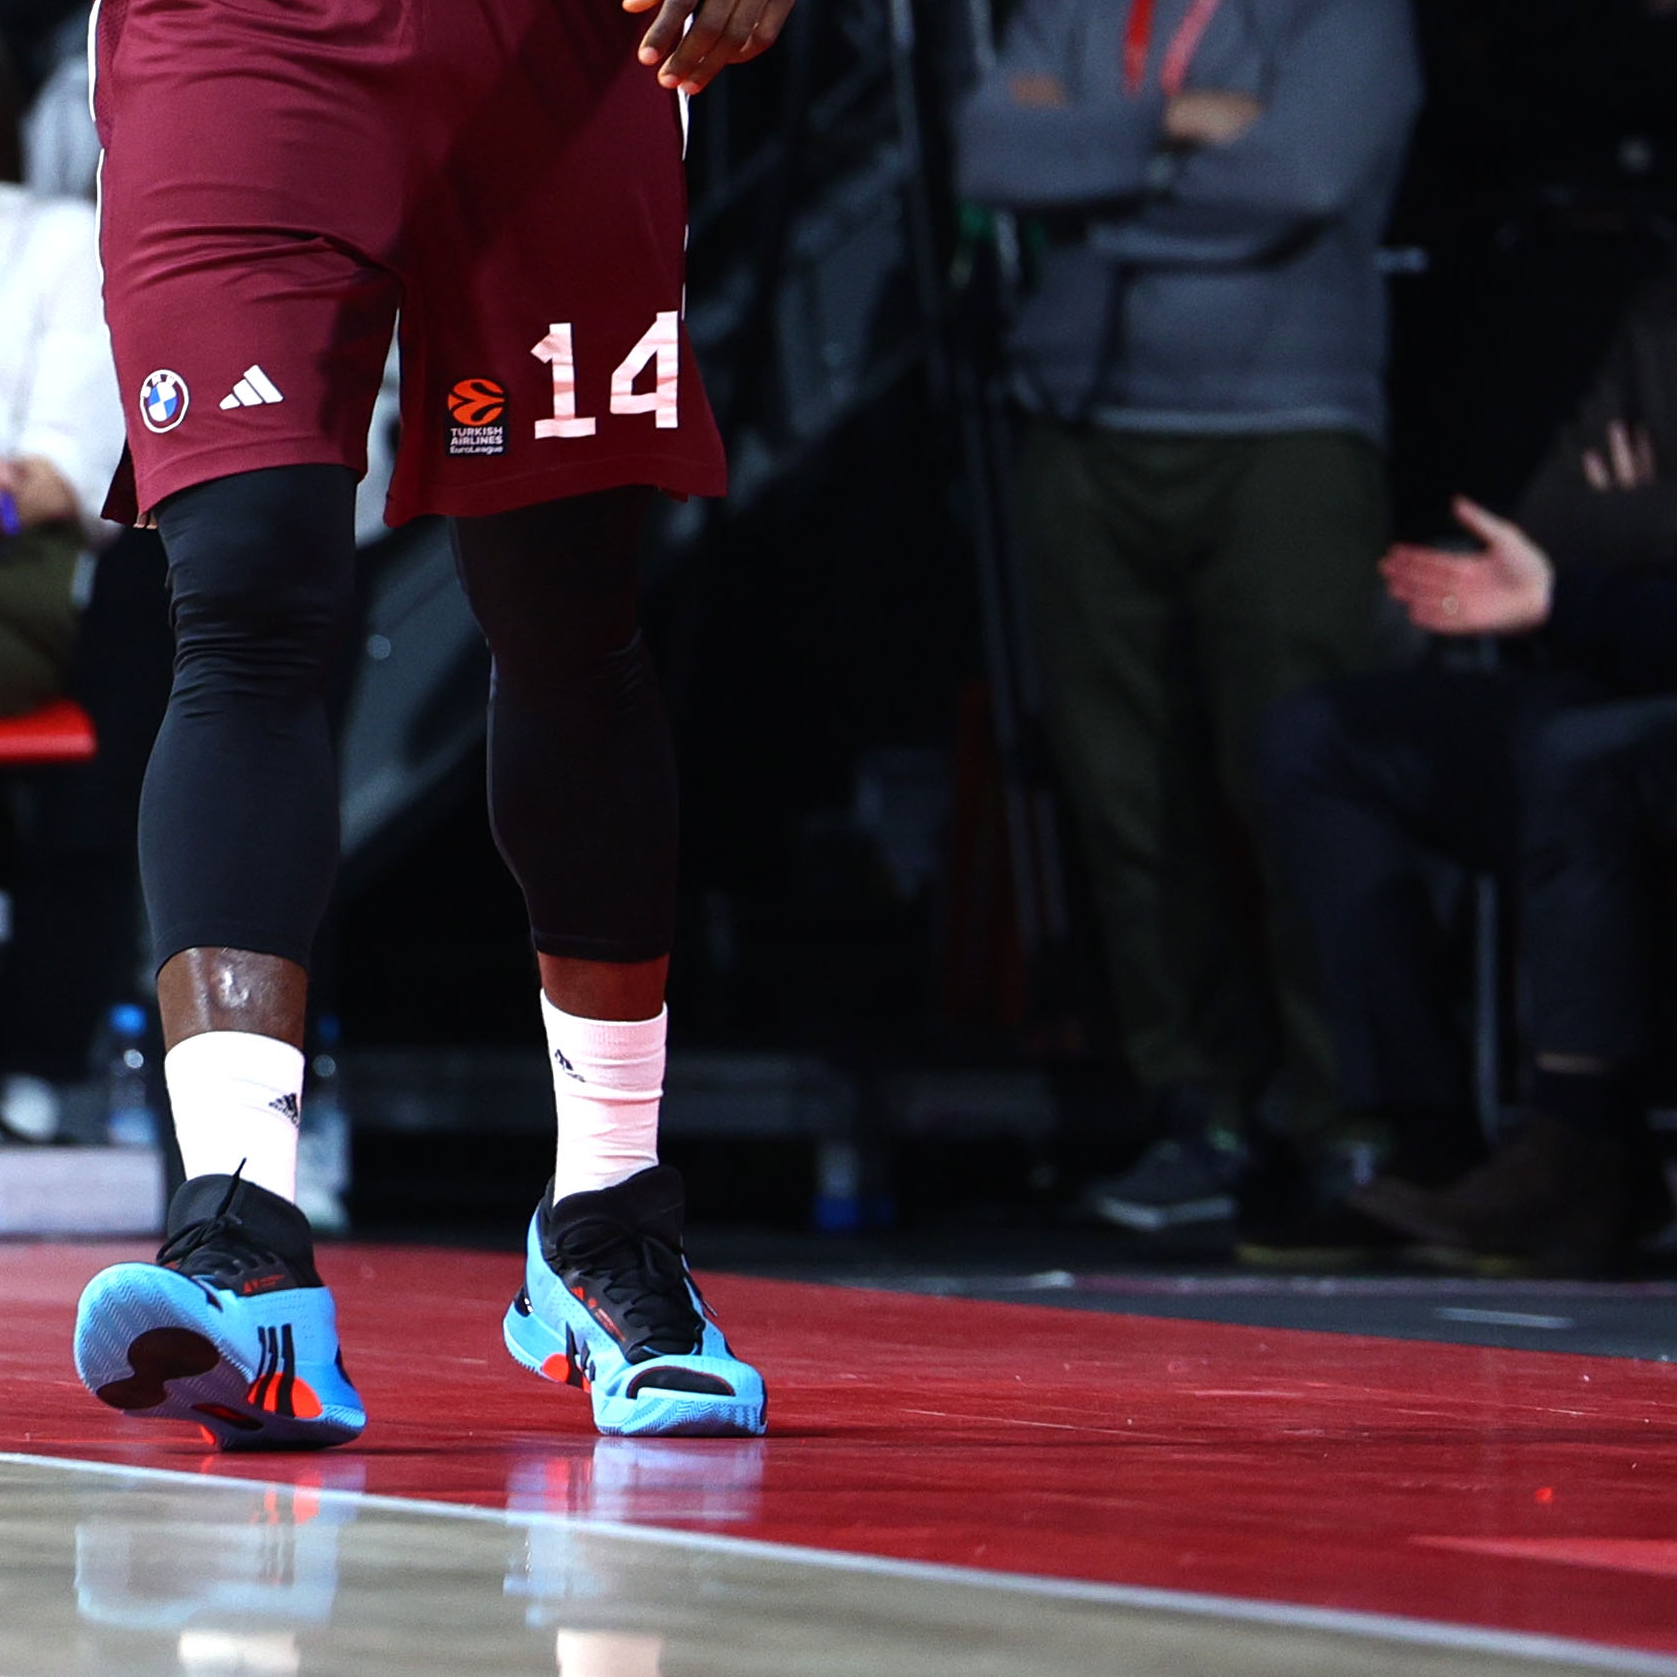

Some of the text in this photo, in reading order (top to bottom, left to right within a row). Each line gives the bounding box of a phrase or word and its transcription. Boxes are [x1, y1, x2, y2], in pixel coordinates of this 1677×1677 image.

[530, 310, 679, 440] 14
[450, 426, 503, 436] TURKISH
[450, 435, 503, 446] AIRLINES
